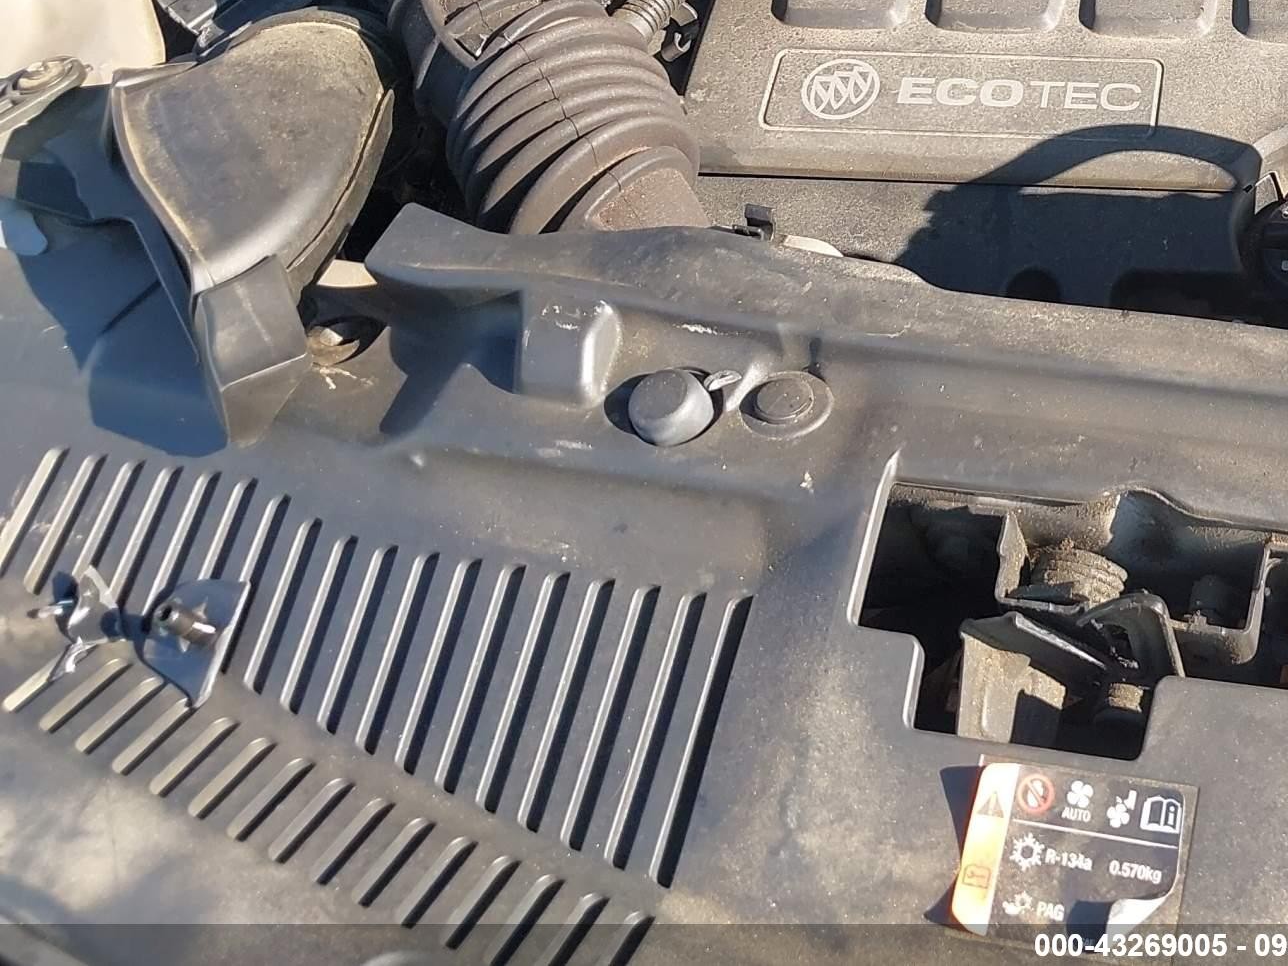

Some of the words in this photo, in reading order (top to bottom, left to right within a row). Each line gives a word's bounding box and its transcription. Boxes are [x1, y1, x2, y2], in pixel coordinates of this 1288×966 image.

[896, 76, 1142, 113] ECOTEC
[1061, 806, 1092, 823] AUTO
[1044, 848, 1093, 872] R-134a
[1108, 859, 1163, 885] 0.570kg
[1036, 900, 1066, 922] PAG
